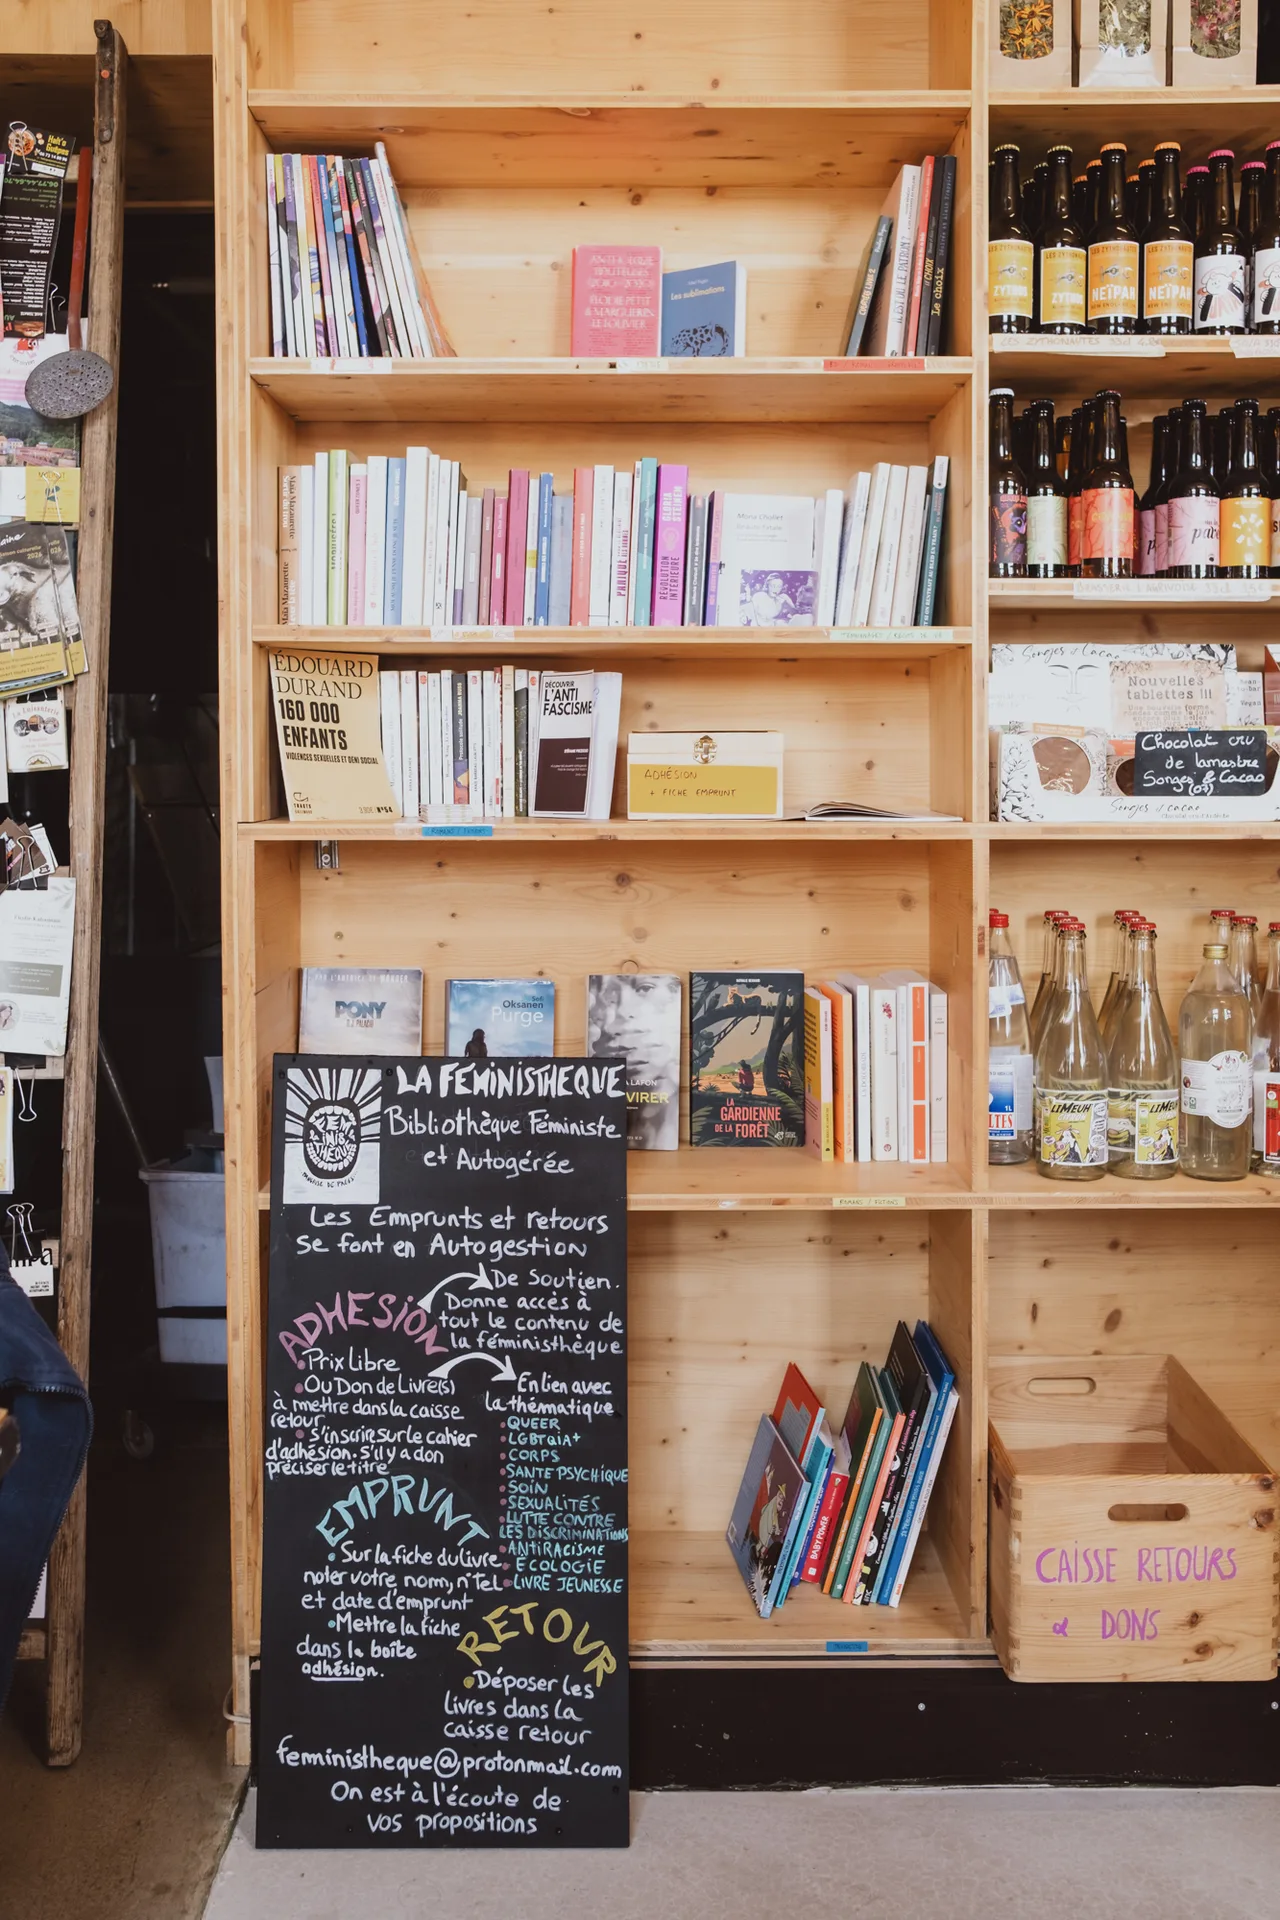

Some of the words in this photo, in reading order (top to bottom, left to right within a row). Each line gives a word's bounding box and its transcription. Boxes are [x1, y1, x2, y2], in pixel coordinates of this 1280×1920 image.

[273, 650, 373, 678] ÉDOUARD
[275, 675, 362, 700] DURAND
[545, 680, 575, 688] DÉCOUVRIR
[1128, 675, 1204, 687] Nouvelles
[544, 687, 579, 702] L'ANTI
[1126, 689, 1193, 700] tablettes
[278, 698, 306, 721] 160
[310, 701, 340, 724] 000
[543, 701, 593, 716] FASCISME
[282, 725, 348, 751] ENFANTS
[1141, 733, 1219, 751] Chocolat
[285, 752, 313, 762] VIOLENCES
[313, 754, 341, 763] SEXUELLES
[360, 757, 379, 765] SOCIAL
[1165, 756, 1184, 770] de
[643, 766, 698, 781] ADHÉSION
[1142, 771, 1194, 792] Songes
[662, 788, 688, 797] FICHE
[334, 1000, 387, 1019] PONY
[502, 1000, 544, 1010] Oksanen
[490, 1008, 544, 1027] Purge
[395, 1064, 432, 1095] LA
[631, 1079, 658, 1087] LAFON
[626, 1091, 670, 1105] VIRER
[726, 1098, 736, 1107] LA
[1050, 1102, 1092, 1113] LIMEUH
[384, 1105, 521, 1142] Bibliothèque
[529, 1109, 622, 1139] Féministe
[720, 1106, 782, 1122] GARDIENNE
[988, 1114, 1013, 1129] LTES
[715, 1124, 724, 1133] DE
[724, 1124, 734, 1133] LA
[735, 1121, 770, 1139] FORÊT
[424, 1144, 448, 1167] et
[456, 1148, 575, 1179] Autogérée
[309, 1206, 352, 1227] Les
[369, 1205, 484, 1231] Emprunts
[490, 1205, 516, 1230] et
[527, 1210, 609, 1234] retours
[338, 1233, 384, 1255] font
[393, 1238, 416, 1258] en
[429, 1233, 588, 1262] Autogestion
[491, 1269, 519, 1288] De
[444, 1292, 509, 1311] Donne
[516, 1291, 569, 1312] accès
[579, 1291, 592, 1311] à
[439, 1310, 480, 1330] tout
[489, 1311, 506, 1330] le
[514, 1316, 589, 1332] contenu
[599, 1311, 624, 1334] de
[450, 1331, 472, 1350] la
[302, 1348, 344, 1373] Prix
[304, 1374, 333, 1394] Ou
[336, 1376, 373, 1395] Don
[377, 1375, 396, 1394] de
[517, 1372, 543, 1393] En
[571, 1378, 612, 1396] avec
[485, 1391, 507, 1413] la
[507, 1394, 614, 1422] thématique
[507, 1415, 561, 1431] QUEER
[508, 1448, 561, 1463] CORPS
[316, 1474, 490, 1548] EMPRUNT
[507, 1513, 550, 1526] LUTTE
[553, 1513, 616, 1528] CONTRE
[499, 1526, 524, 1540] LES
[810, 1539, 822, 1560] BABY
[816, 1516, 829, 1540] POWER
[341, 1540, 373, 1564] Sur
[375, 1543, 392, 1565] la
[392, 1544, 432, 1566] fiche
[437, 1548, 459, 1568] du
[1035, 1540, 1118, 1584] CAISSE
[1137, 1545, 1238, 1583] RETOURS
[557, 1578, 624, 1594] JEUNESSE
[336, 1612, 396, 1635] Mettre
[400, 1615, 416, 1636] la
[1101, 1607, 1162, 1641] DONS
[296, 1640, 341, 1658] dans
[370, 1640, 418, 1660] boîte
[456, 1601, 617, 1688] RETOUR
[473, 1666, 559, 1694] Déposer
[563, 1676, 595, 1700] les
[503, 1699, 549, 1721] dans
[443, 1721, 509, 1742] caisse
[518, 1724, 592, 1746] retour
[276, 1734, 622, 1779] feministheque@protonmail.com
[331, 1781, 364, 1802] On
[371, 1785, 406, 1803] est
[411, 1782, 429, 1804] à
[532, 1786, 562, 1811] de
[415, 1813, 538, 1838] propositions
